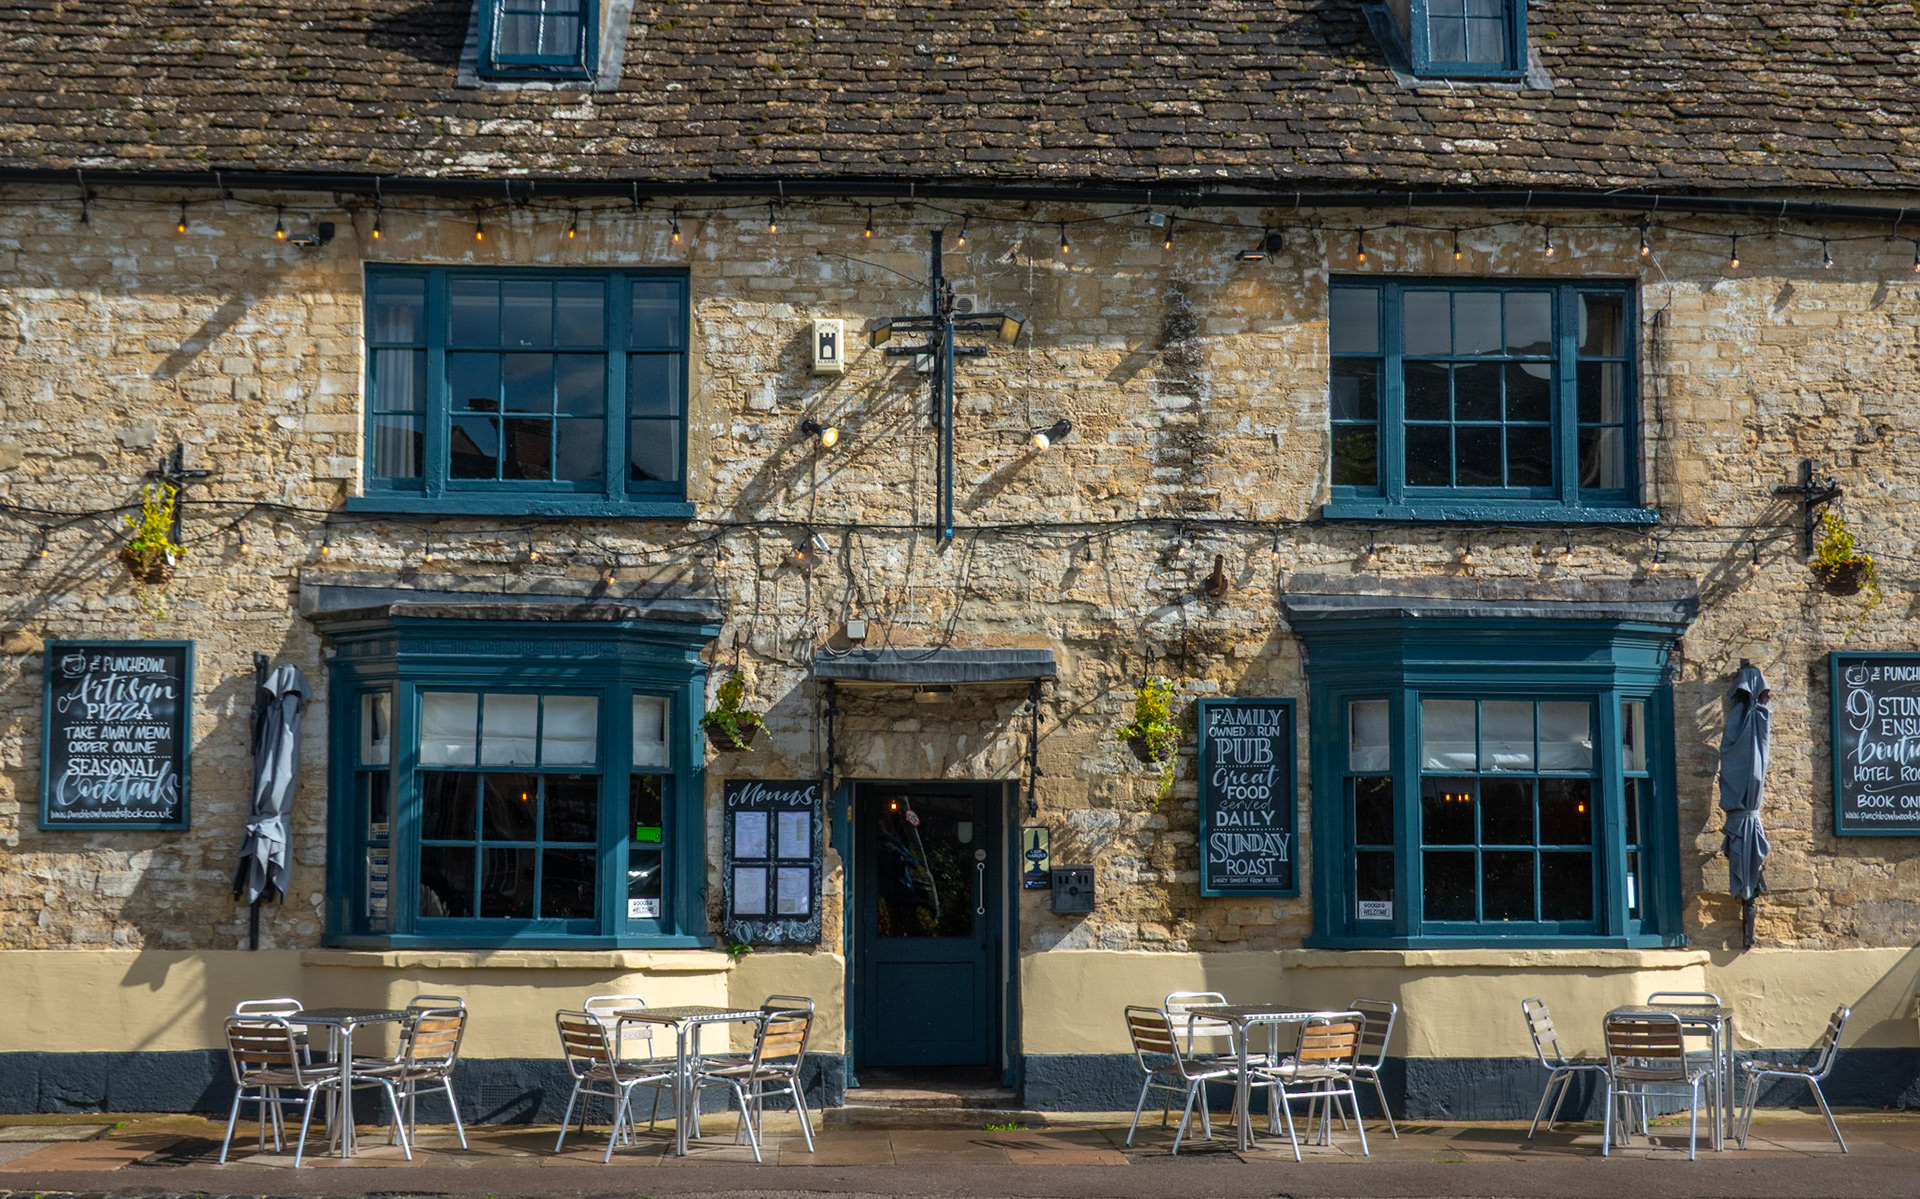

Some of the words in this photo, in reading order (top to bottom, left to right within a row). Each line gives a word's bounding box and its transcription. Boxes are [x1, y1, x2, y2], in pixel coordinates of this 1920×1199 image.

[816, 323, 839, 333] FORTRESS
[90, 655, 101, 672] The
[103, 656, 166, 672] PUNCHBOWL
[1871, 666, 1880, 682] The
[1884, 666, 1920, 681] PUNCH
[58, 673, 179, 713] Artisan
[86, 703, 153, 721] PIZZA
[1210, 708, 1283, 726] FAMILY
[1846, 689, 1875, 730] 9
[64, 726, 98, 739] TAKE
[101, 726, 131, 739] AWAY
[135, 727, 171, 740] MENU
[1209, 726, 1246, 737] OWNED
[1257, 726, 1280, 737] RUN
[68, 741, 108, 753] ORDER
[112, 741, 158, 753] ONLINE
[1215, 738, 1273, 764] PUB
[67, 759, 158, 777] SEASONAL
[1854, 766, 1894, 781] HOTEL
[56, 761, 180, 805] Cocktails
[1212, 765, 1280, 793] Great
[728, 782, 816, 806] Menus
[1227, 786, 1270, 799] FOOD
[1857, 794, 1895, 808] BOOK
[1219, 796, 1273, 811] served
[1216, 810, 1275, 827] DAILY
[1210, 832, 1291, 863] SUNDAY
[1226, 858, 1275, 875] ROAST
